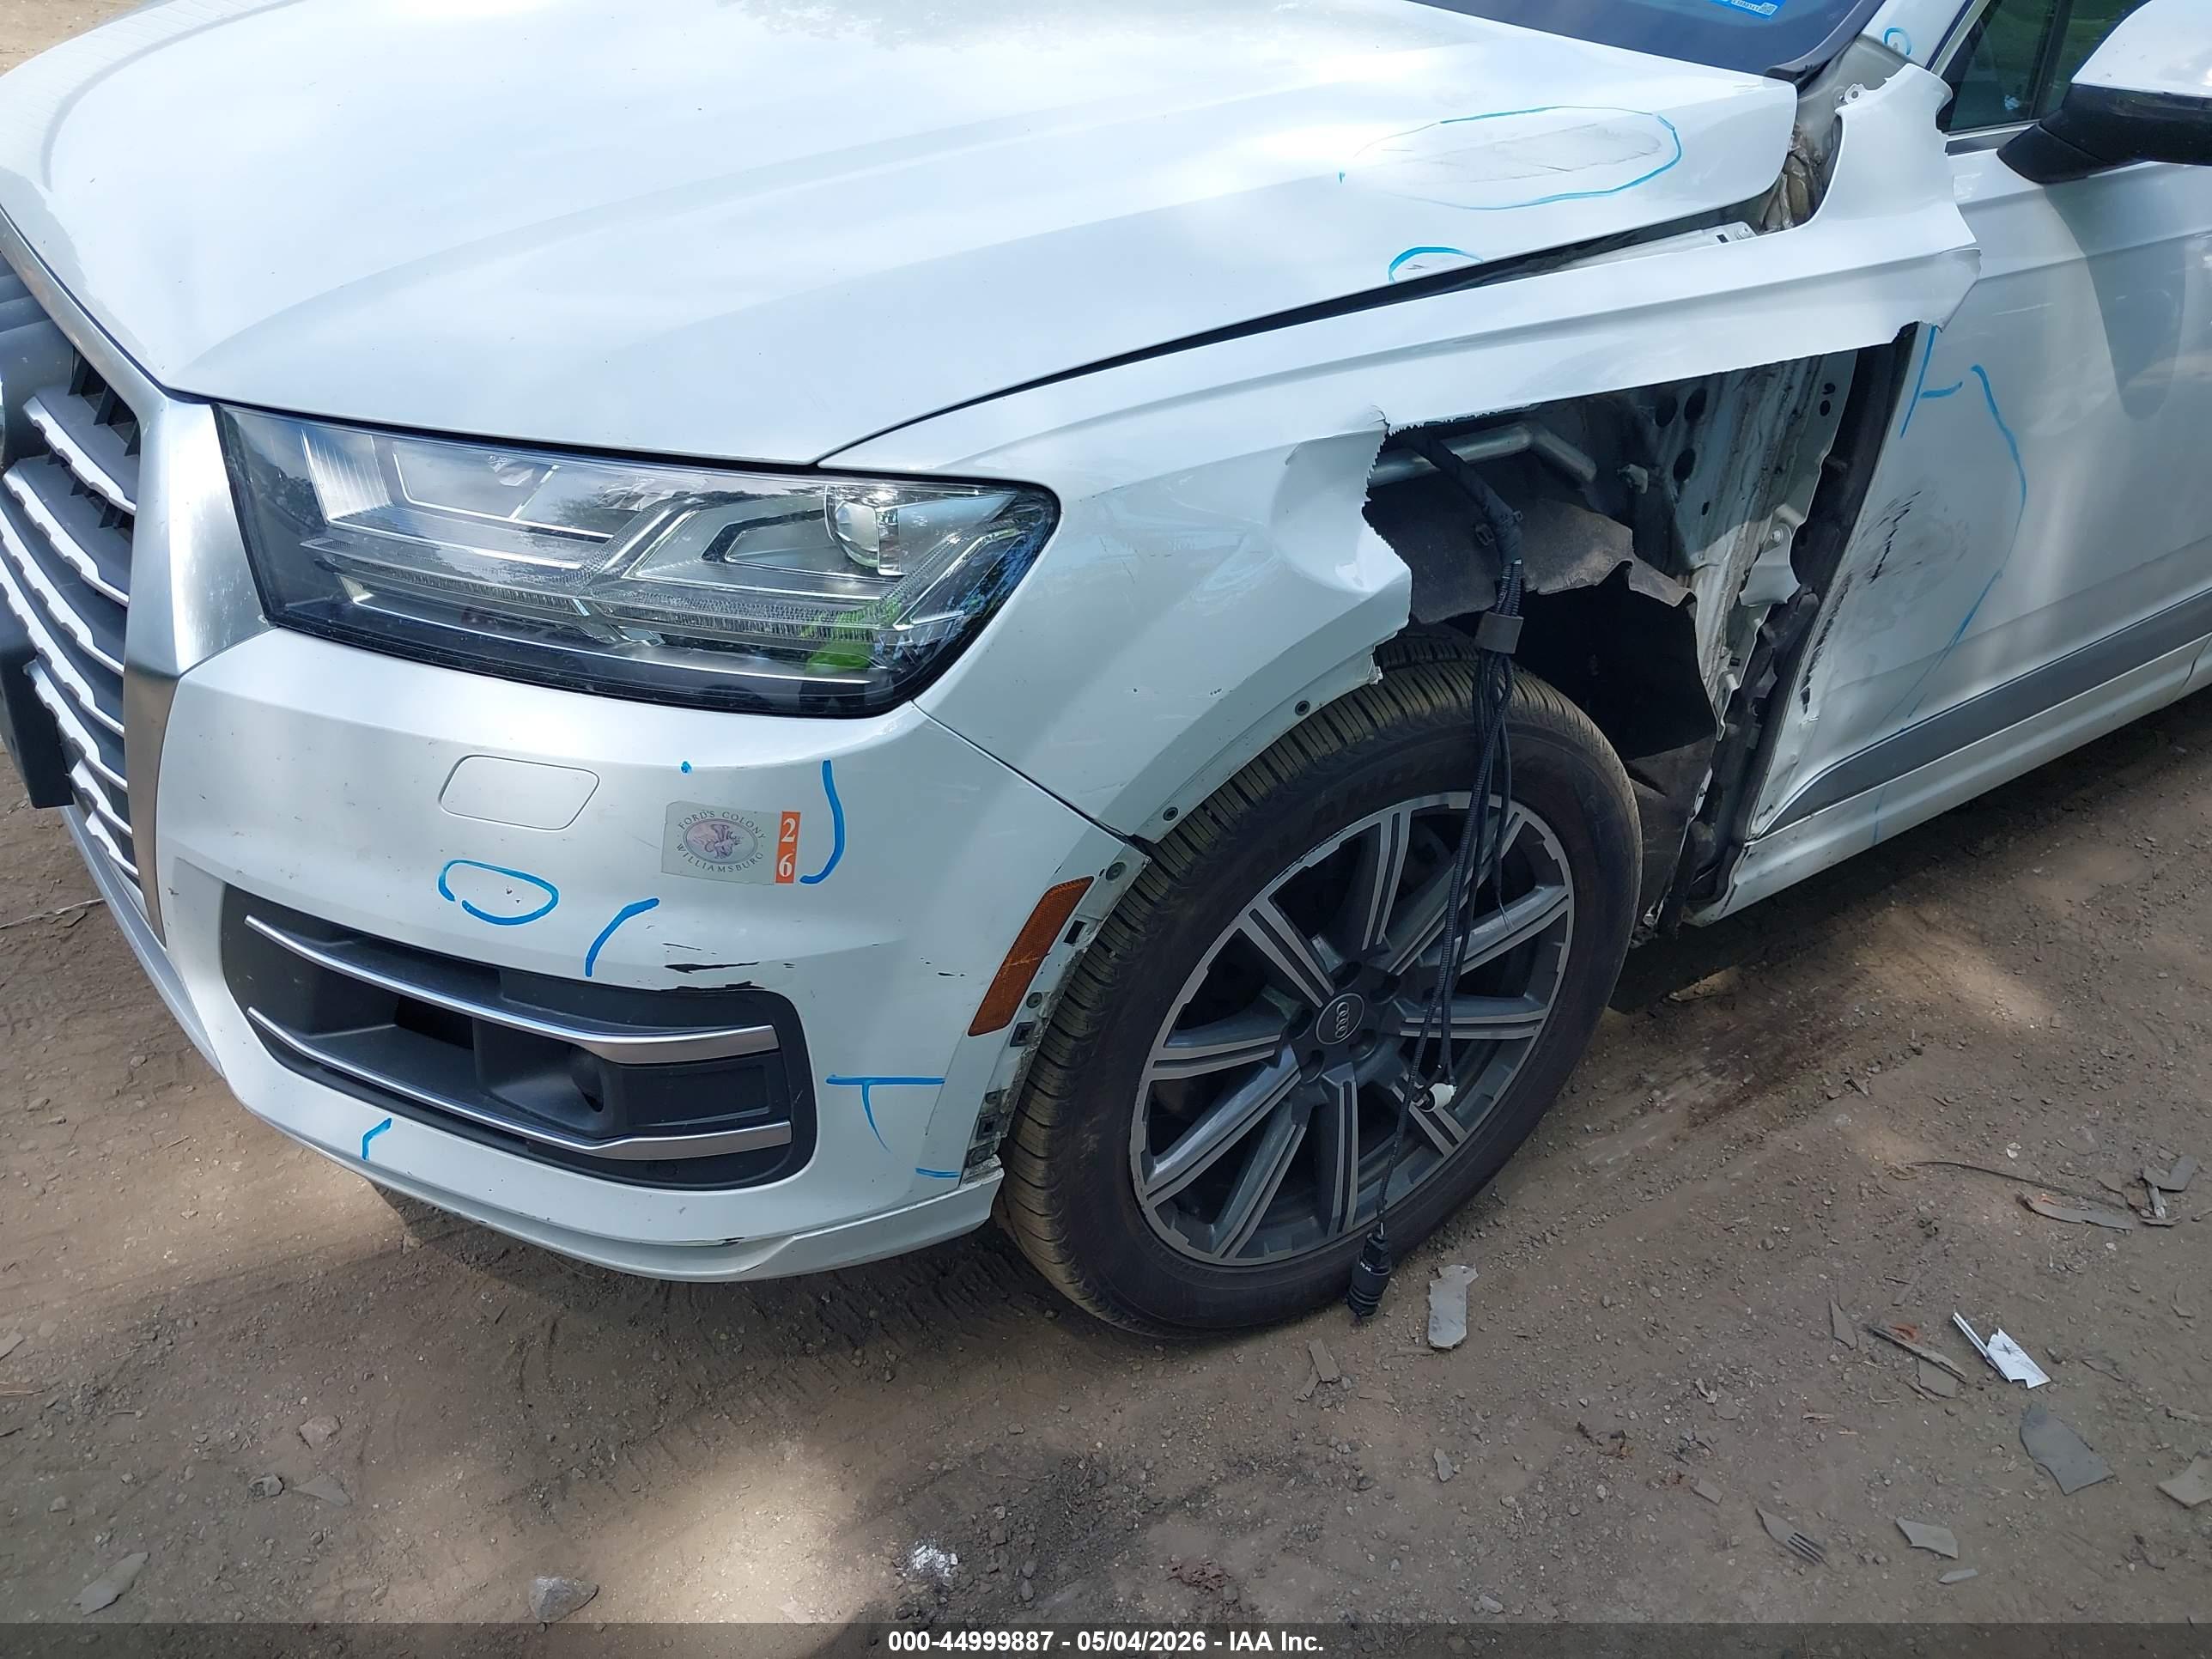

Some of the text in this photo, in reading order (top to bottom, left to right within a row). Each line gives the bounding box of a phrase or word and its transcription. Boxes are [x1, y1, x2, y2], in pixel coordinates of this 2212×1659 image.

[678, 811, 767, 839] FORD'S COLONY
[781, 817, 796, 842] 2
[677, 843, 763, 873] WILLIAMSBURG
[778, 853, 793, 878] 6
